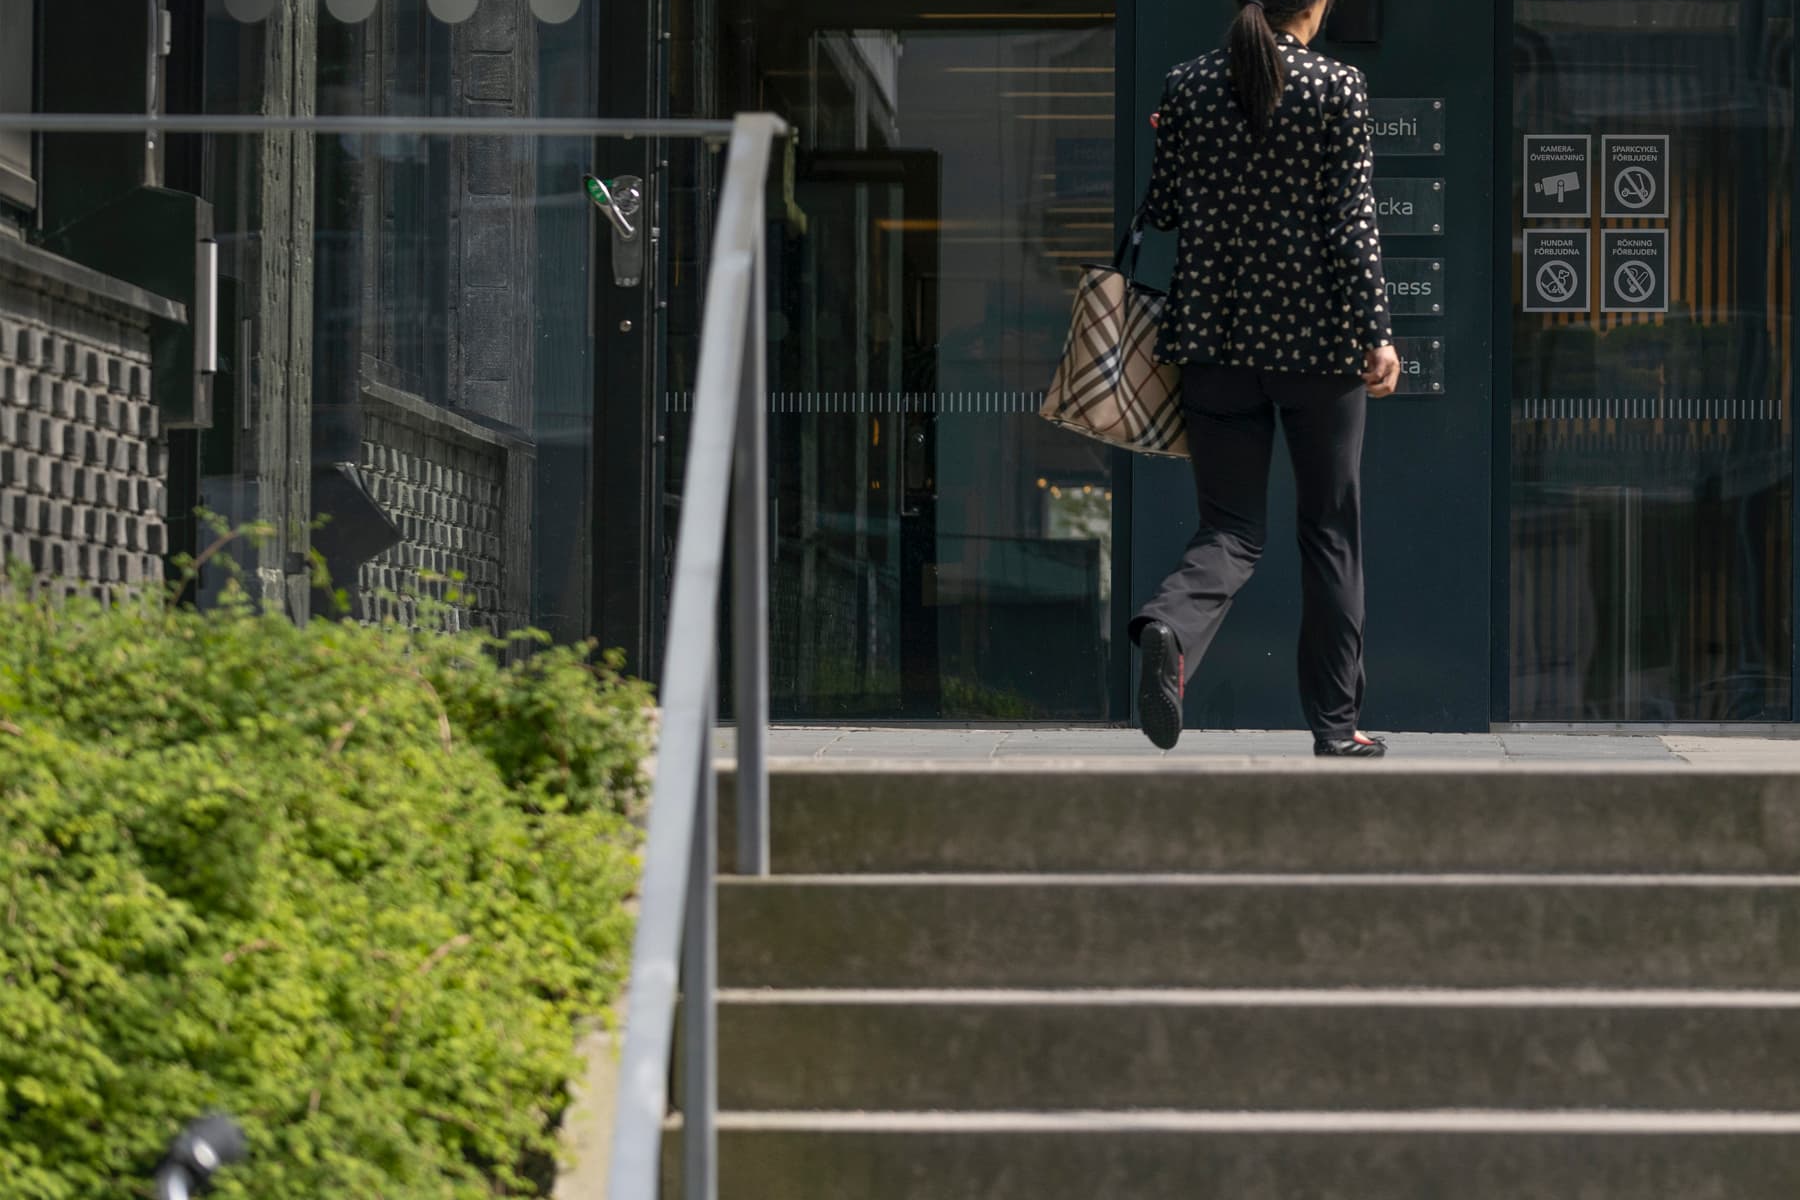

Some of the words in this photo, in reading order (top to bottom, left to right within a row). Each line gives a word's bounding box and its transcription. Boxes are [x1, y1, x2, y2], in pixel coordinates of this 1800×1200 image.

[1530, 153, 1585, 161] ÖVERVAKNING
[1612, 153, 1658, 161] FÖRBJUDEN
[1616, 238, 1653, 247] RÖKNING
[1534, 247, 1580, 255] FÖRBJUDNA
[1612, 247, 1657, 255] FÖRBJUDEN
[1384, 281, 1432, 296] ness
